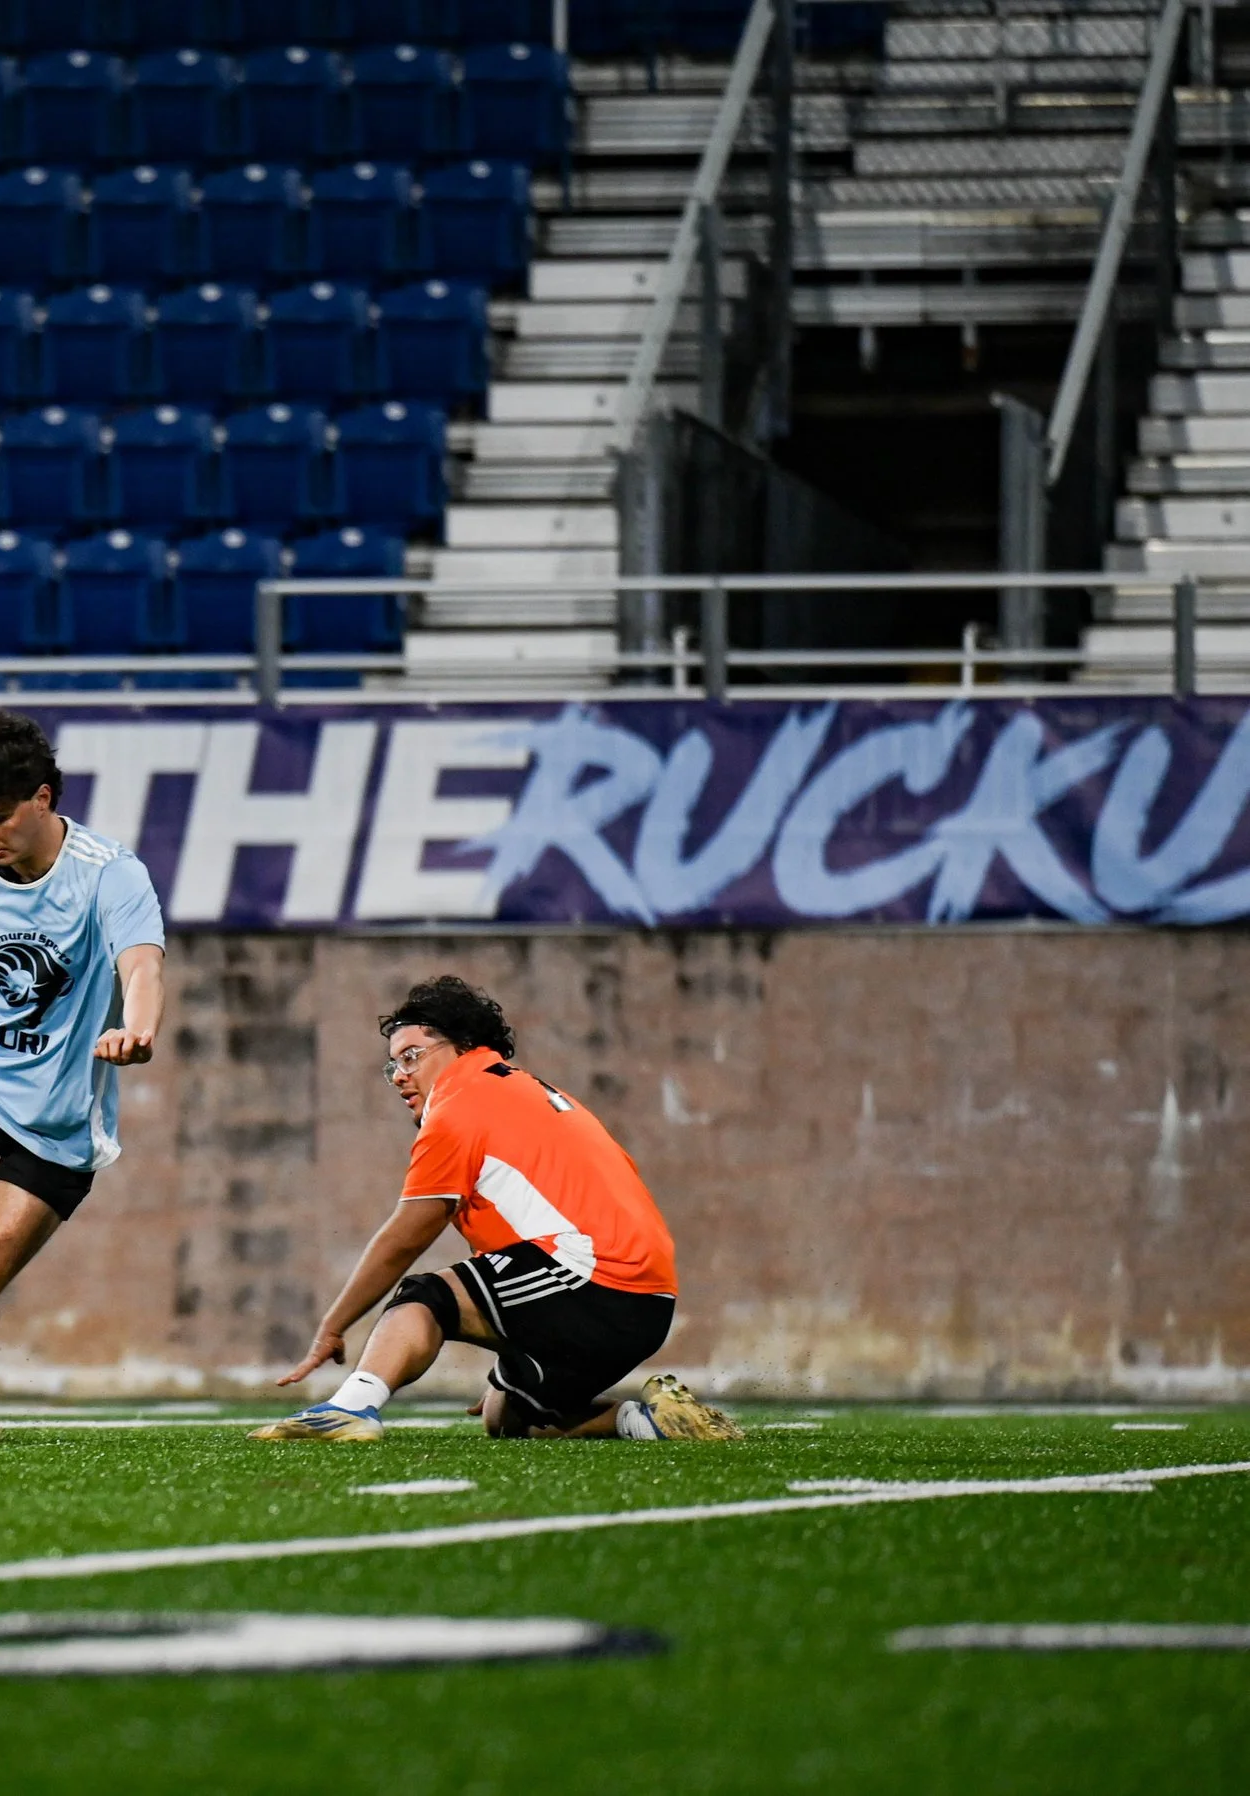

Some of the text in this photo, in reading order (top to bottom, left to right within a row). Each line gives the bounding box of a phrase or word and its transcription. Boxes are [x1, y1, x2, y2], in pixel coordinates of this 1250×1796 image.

[54, 720, 536, 920] THE
[454, 700, 1250, 927] RUCKU
[39, 933, 73, 965] Sports
